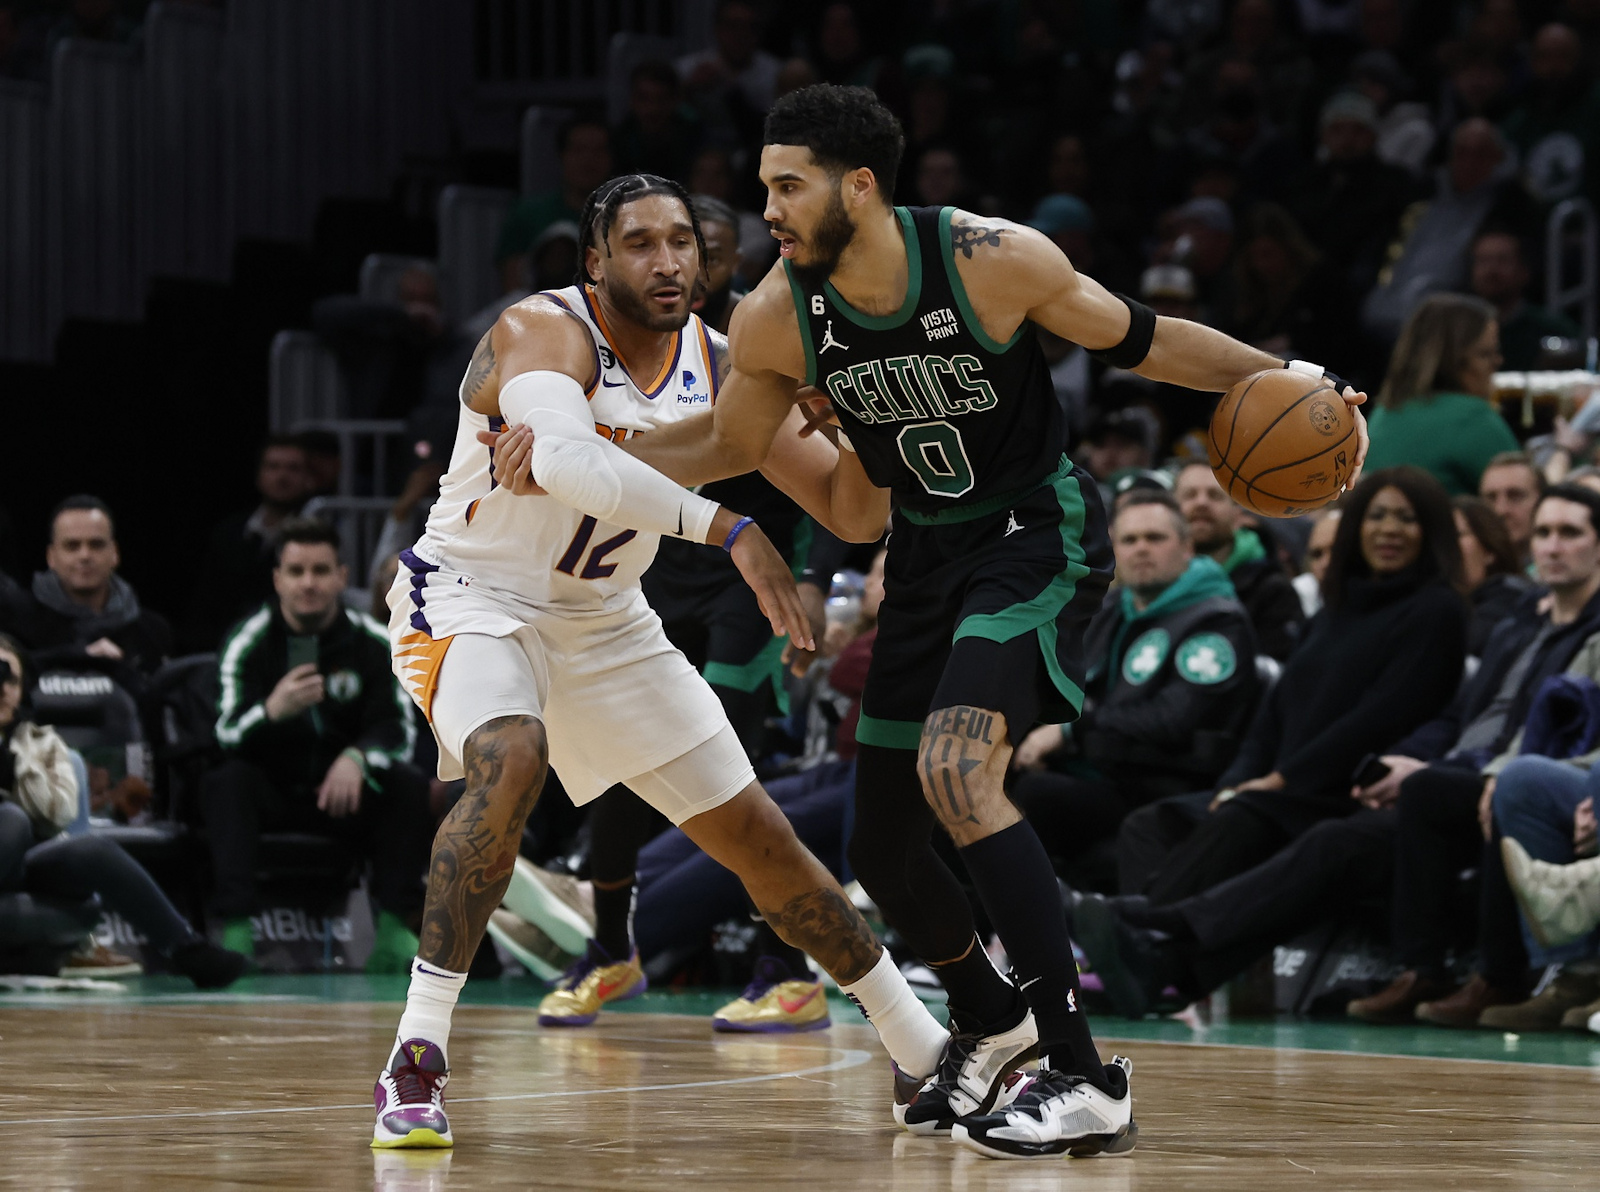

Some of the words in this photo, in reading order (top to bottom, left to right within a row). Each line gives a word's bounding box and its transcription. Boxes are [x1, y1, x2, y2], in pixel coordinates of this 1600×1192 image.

[811, 294, 826, 315] 6
[920, 307, 957, 331] VISTA
[925, 322, 960, 342] PRINT
[677, 393, 709, 405] PayPal
[825, 354, 999, 424] CELTICS
[896, 420, 975, 498] 0
